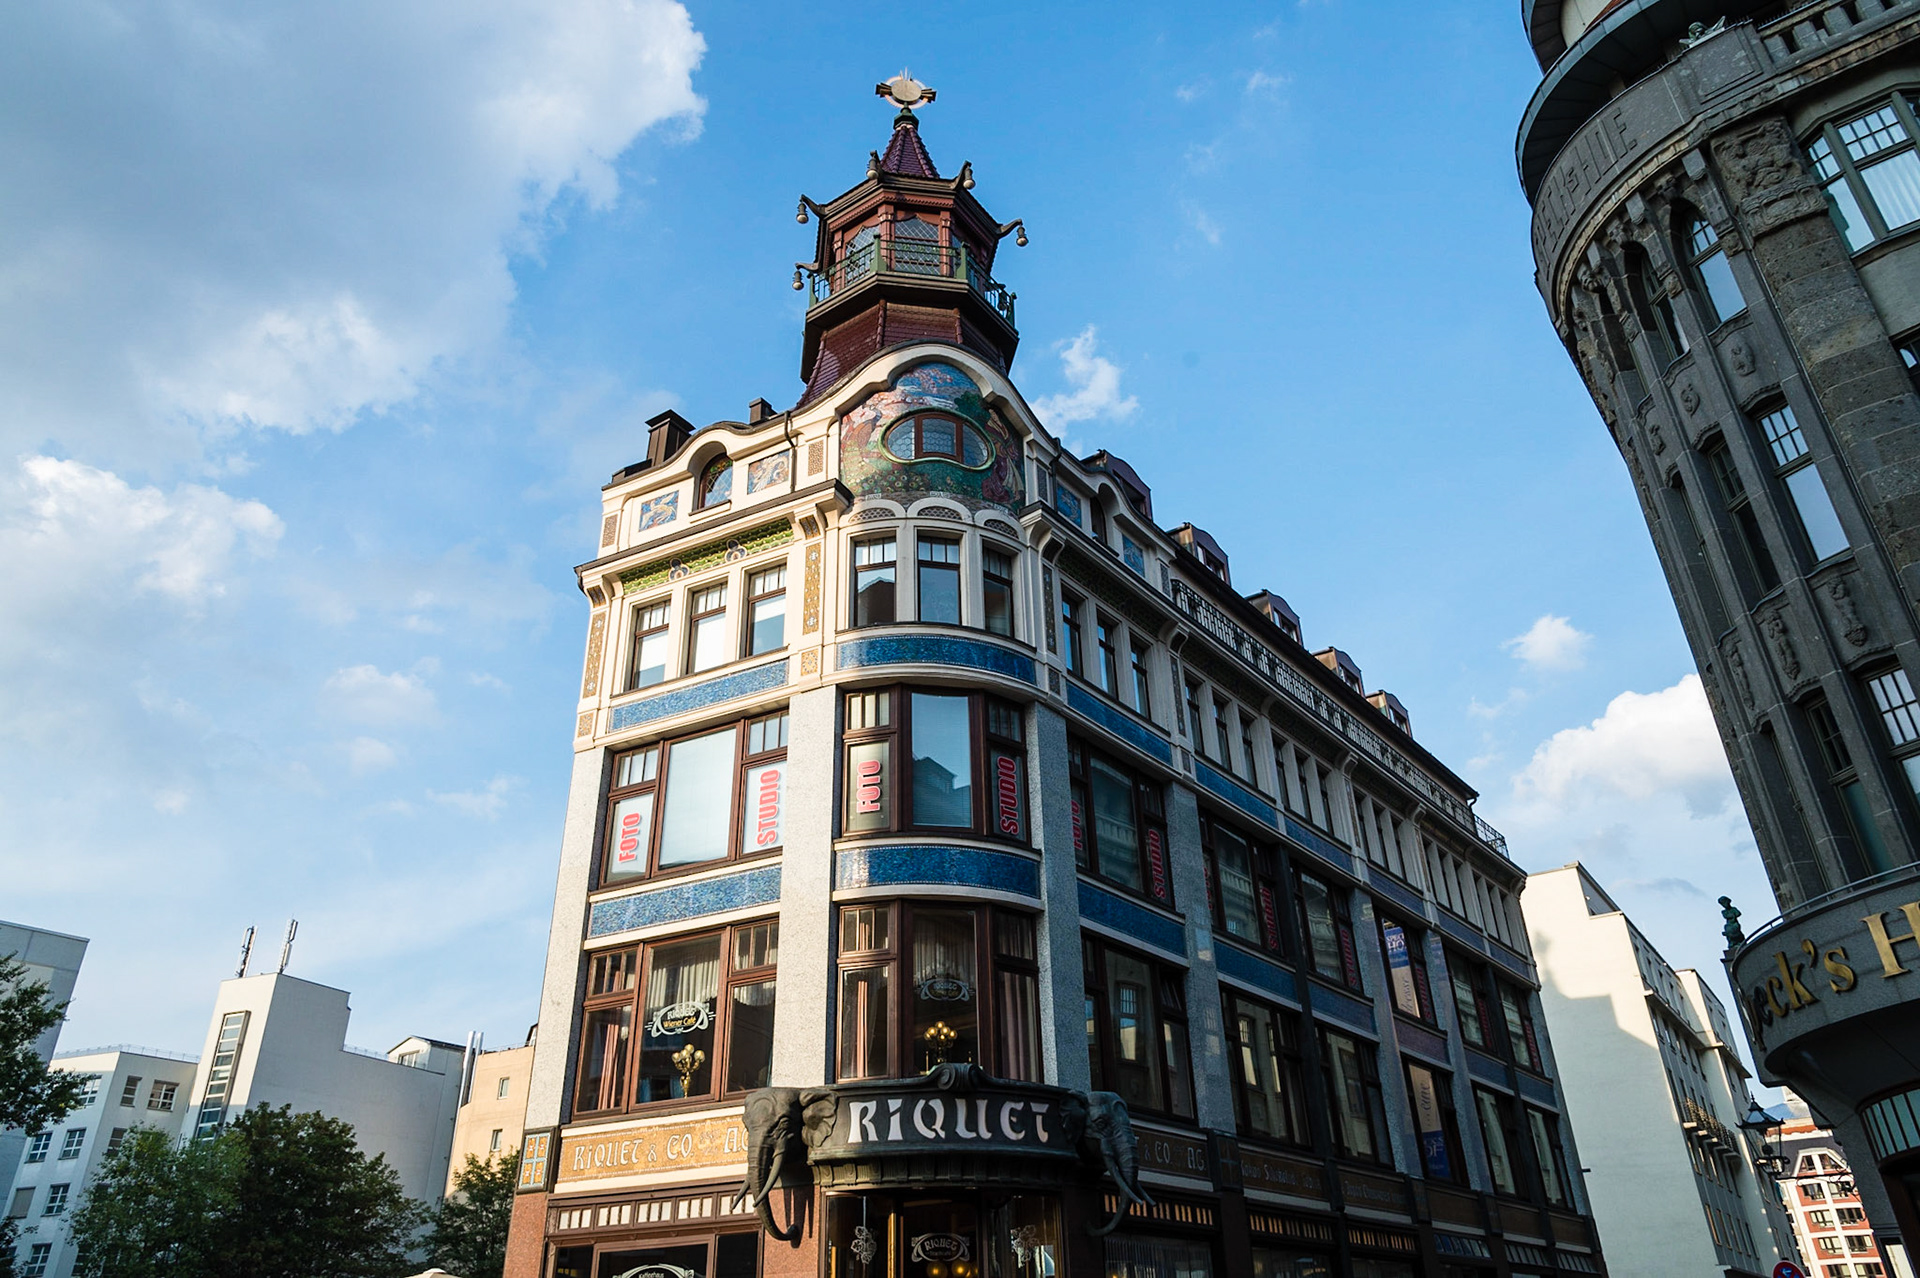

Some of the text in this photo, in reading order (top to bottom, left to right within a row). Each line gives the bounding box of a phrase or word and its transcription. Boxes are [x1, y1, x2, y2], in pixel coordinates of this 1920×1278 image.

[757, 769, 779, 846] STUDIO
[856, 760, 880, 813] FOTO
[997, 756, 1019, 835] STUDIO
[619, 812, 640, 862] FOTO
[1148, 829, 1166, 899] STUDIO
[1738, 938, 1857, 1053] peck's
[847, 1098, 1048, 1143] RIQUET
[573, 1139, 643, 1171] RIQUET
